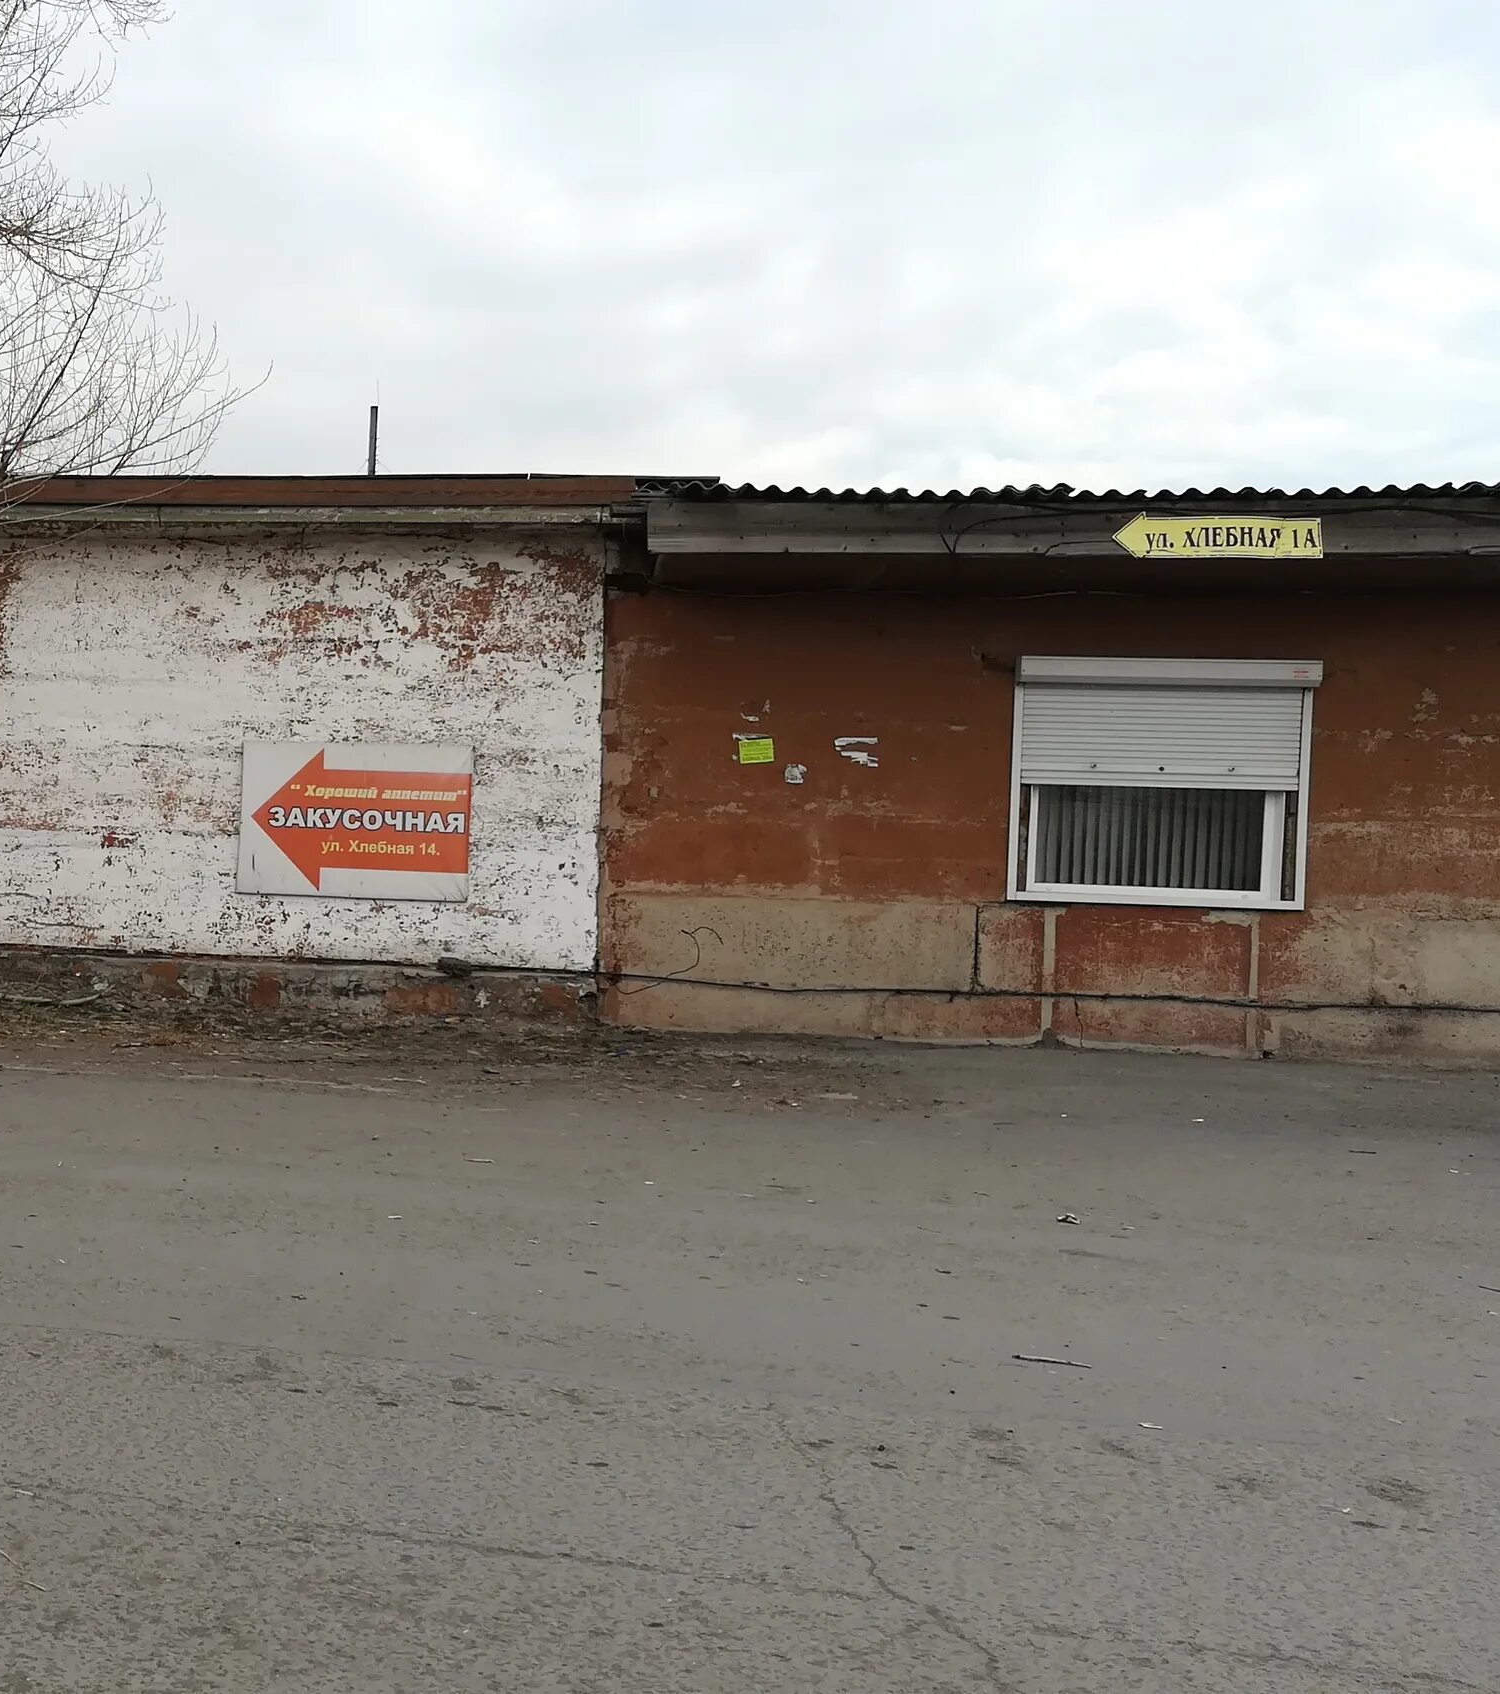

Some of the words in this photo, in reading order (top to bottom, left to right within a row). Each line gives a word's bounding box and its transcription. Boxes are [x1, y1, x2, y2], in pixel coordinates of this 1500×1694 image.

[1182, 526, 1281, 549] ХЛЕБНАЯ
[304, 784, 379, 799] Хороший
[268, 806, 466, 834] ЗАКУСОЧНАЯ
[321, 841, 344, 854] ул.
[348, 839, 415, 855] Хлебная
[419, 843, 441, 856] 14.
